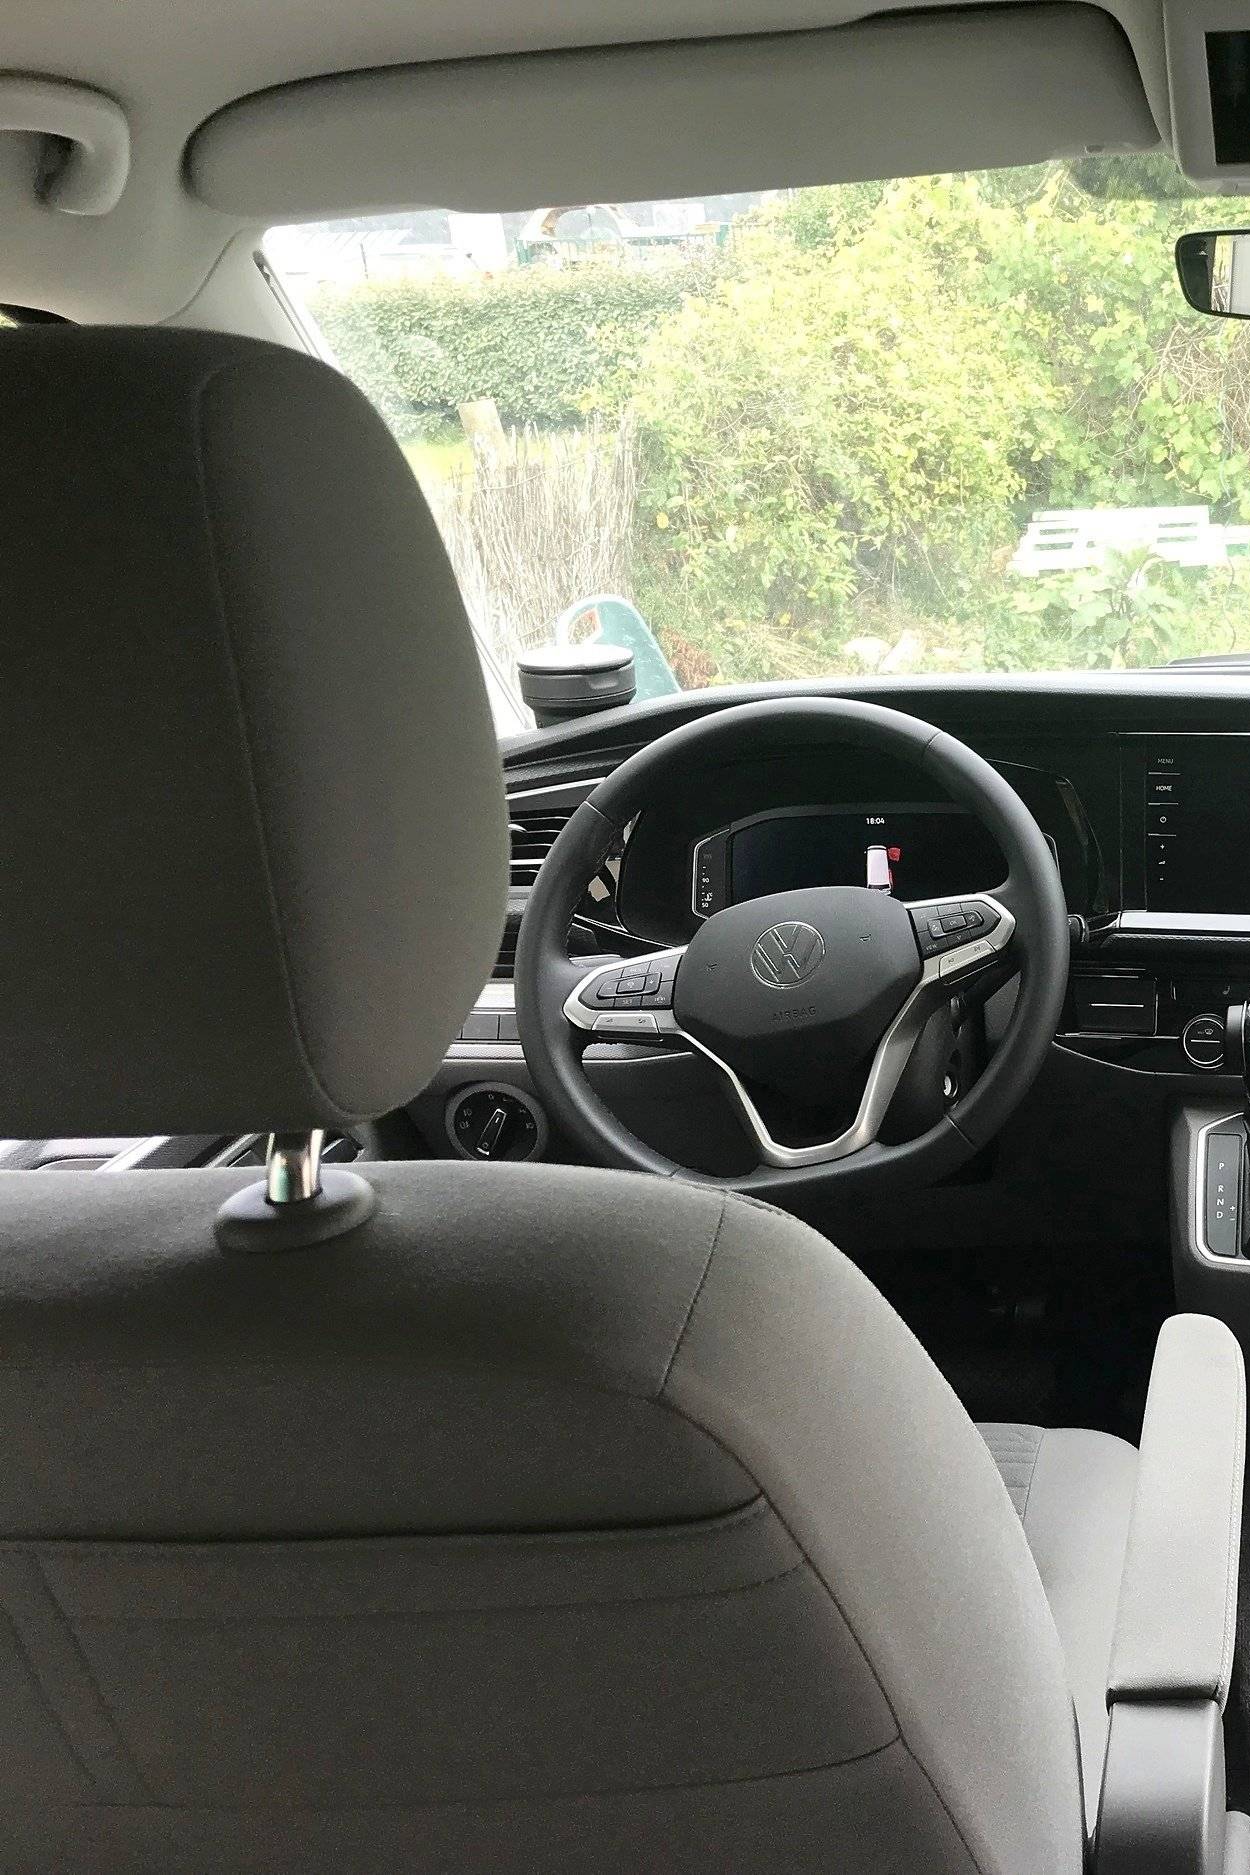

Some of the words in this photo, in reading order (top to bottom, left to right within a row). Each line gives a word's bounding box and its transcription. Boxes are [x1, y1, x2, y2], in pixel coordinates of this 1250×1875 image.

[865, 817, 885, 825] 18:04
[768, 1006, 817, 1020] AIRBAG
[1219, 1162, 1225, 1170] P
[1218, 1184, 1224, 1192] R
[1216, 1198, 1225, 1206] N
[1216, 1211, 1223, 1219] D
